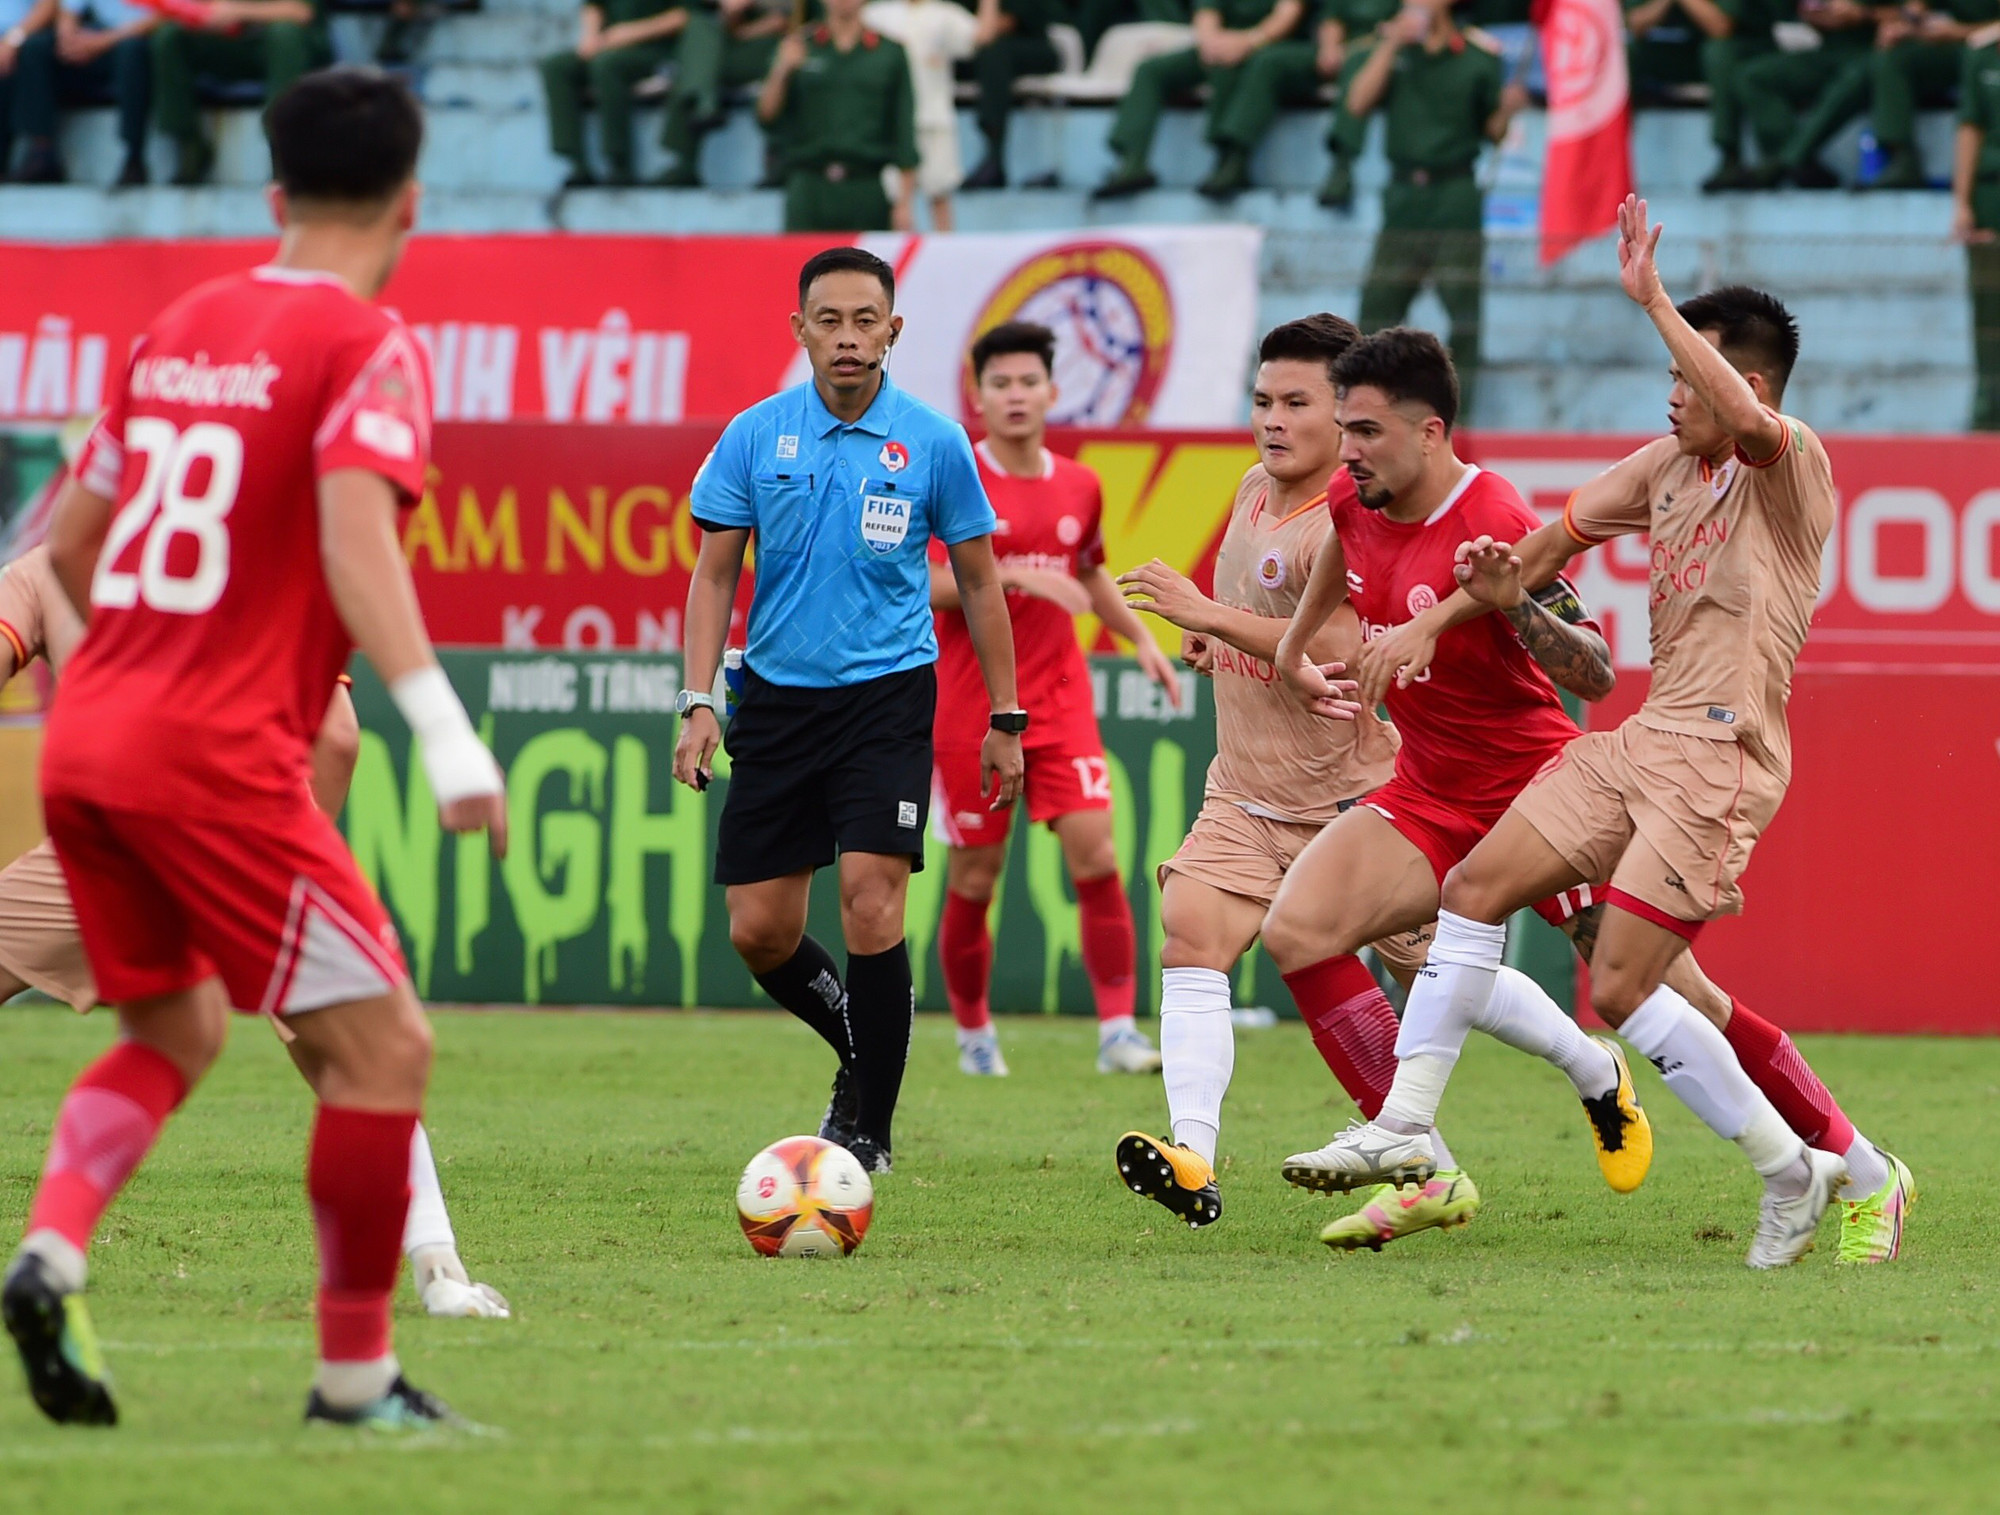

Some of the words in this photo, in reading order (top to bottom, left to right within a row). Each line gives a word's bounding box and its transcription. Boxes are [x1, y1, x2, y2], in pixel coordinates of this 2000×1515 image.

[90, 416, 243, 614] 28
[868, 500, 905, 518] FIFA
[865, 522, 903, 534] REFEREE
[1071, 755, 1111, 799] 12
